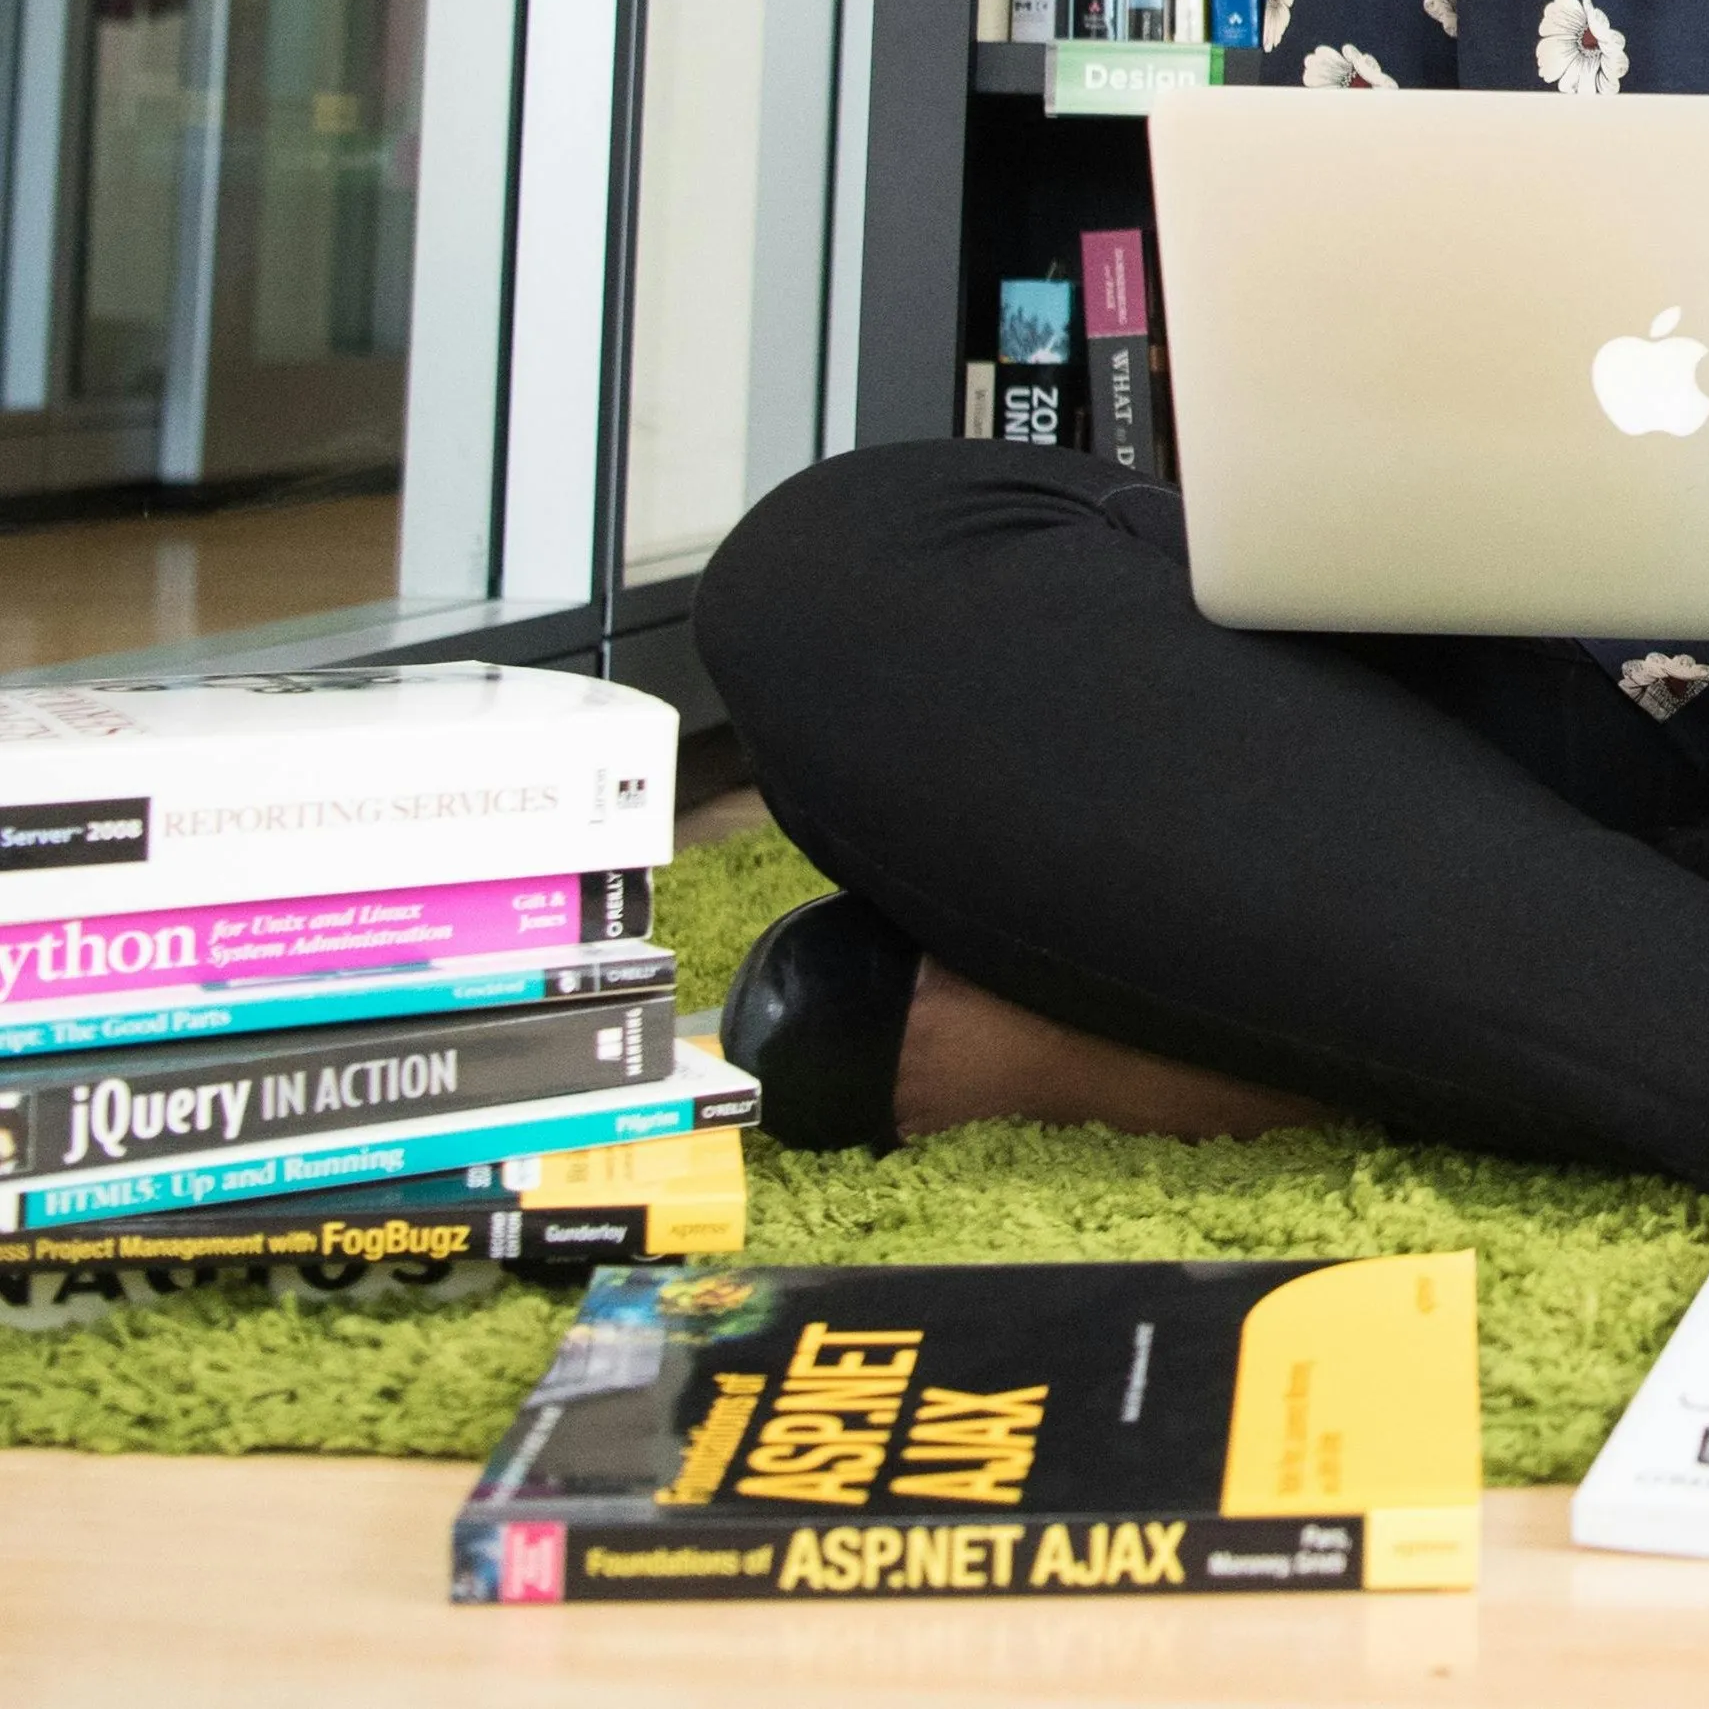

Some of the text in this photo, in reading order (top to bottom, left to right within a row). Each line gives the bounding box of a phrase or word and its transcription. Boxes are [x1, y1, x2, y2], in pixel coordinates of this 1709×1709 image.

[1083, 63, 1196, 92] Design
[1111, 348, 1134, 425] WHAT
[0, 784, 560, 849] Server 2008 REPORTING SERVICES
[517, 914, 568, 933] Jones
[548, 891, 567, 909] &
[0, 902, 424, 1001] ython for Unix and Linux
[208, 923, 454, 970] System Administration
[51, 1007, 232, 1045] The Good Parts
[62, 1049, 458, 1166] jQuery IN ACTION
[45, 1145, 406, 1217] HTML5: Up and Running
[34, 1217, 472, 1263] Project Management with FogBugz
[544, 1225, 629, 1244] Gunderloy
[736, 1320, 925, 1506] ASP.NET
[888, 1384, 1050, 1504] AJAX
[584, 1521, 1188, 1592] Foundations of ASP.NET AJAX
